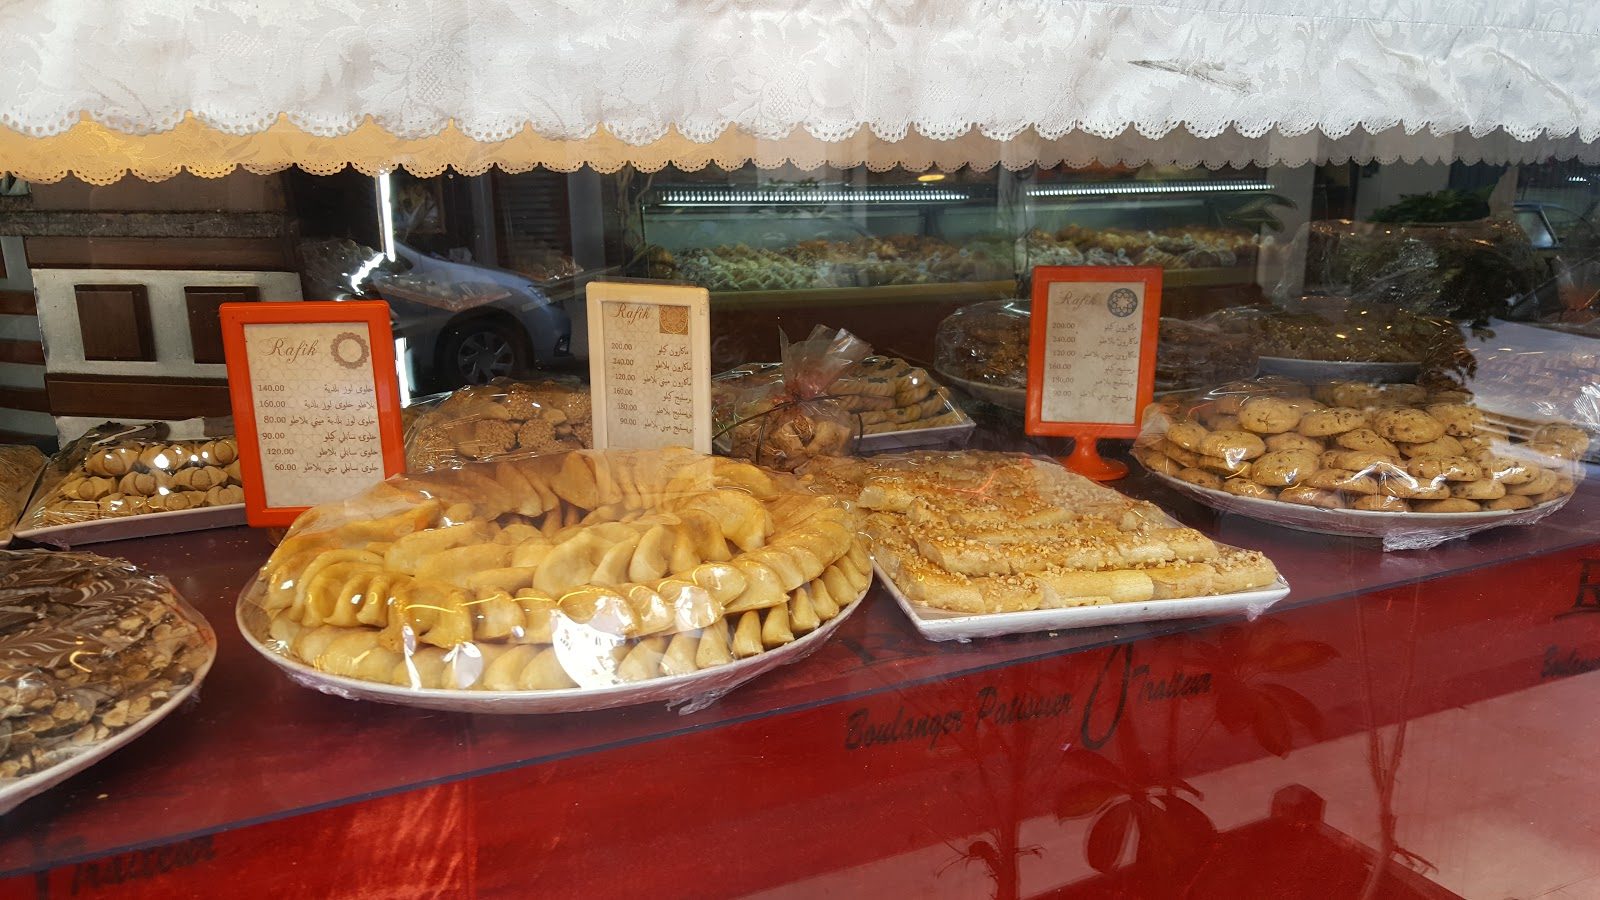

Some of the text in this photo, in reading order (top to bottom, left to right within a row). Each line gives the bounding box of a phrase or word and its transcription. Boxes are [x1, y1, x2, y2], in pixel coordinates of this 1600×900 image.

[1056, 290, 1100, 311] Rafik
[610, 302, 650, 325] Rafik
[260, 336, 319, 364] Rafik
[611, 342, 633, 351] 200.00
[615, 373, 635, 381] 120.00
[258, 383, 374, 394] حلوى لوز بلدية 140.00
[614, 387, 633, 396] 160.00
[260, 400, 286, 408] 160.00
[304, 400, 319, 409] بلدية
[321, 401, 332, 411] لوز
[335, 402, 354, 411] حلوى
[617, 402, 637, 411] 180.00
[263, 415, 286, 424] 80.00
[311, 418, 325, 427] ميني
[327, 416, 342, 425] بلدية
[345, 416, 356, 426] لوز
[357, 417, 375, 427] حلوى
[262, 432, 285, 440] 90.00
[323, 430, 337, 442] كيلو
[359, 432, 377, 442] حلوى
[318, 447, 337, 457] بلاطو
[360, 448, 378, 457] حلوى
[275, 463, 296, 471] 60.00
[302, 462, 321, 473] بلاطو
[323, 466, 338, 474] ميني
[361, 463, 379, 473] حلوى
[845, 706, 964, 752] Boulanger
